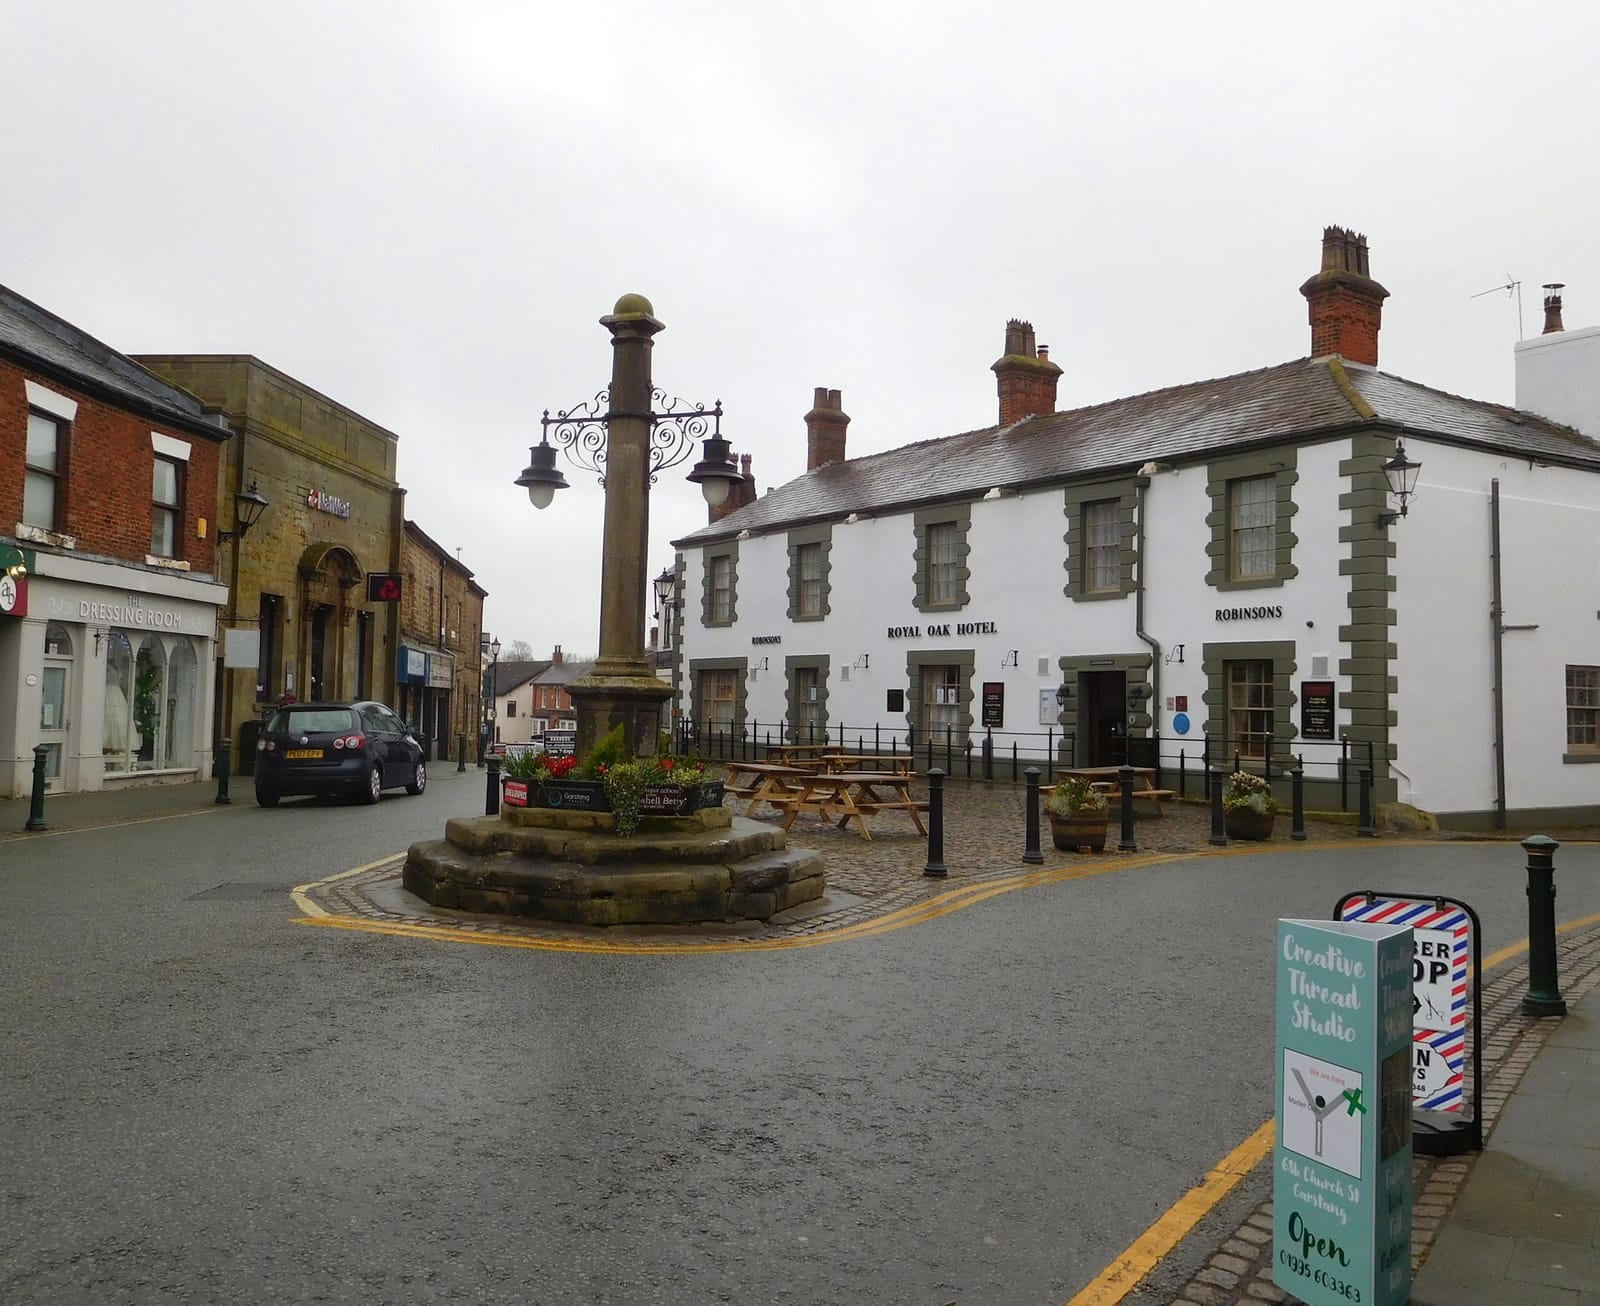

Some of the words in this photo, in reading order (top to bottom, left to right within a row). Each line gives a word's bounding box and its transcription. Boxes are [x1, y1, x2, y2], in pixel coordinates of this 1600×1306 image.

[79, 600, 143, 625] DRESSING
[147, 610, 182, 629] ROOM
[127, 595, 142, 607] THE
[1215, 605, 1283, 622] ROBINSONS
[752, 635, 782, 645] ROBINSONS
[887, 626, 922, 639] ROYAL
[927, 624, 951, 637] OAK
[956, 621, 998, 635] HOTEL
[564, 792, 590, 802] Garstang
[1283, 934, 1367, 979] Creative
[1287, 966, 1361, 1010] Thread
[1291, 999, 1356, 1042] Studio
[1310, 1068, 1320, 1076] We
[1288, 1096, 1307, 1110] Market
[1303, 1166, 1344, 1198] Church
[1347, 1184, 1361, 1205] St
[1293, 1182, 1347, 1227] Garstang
[1288, 1211, 1351, 1268] Open
[1279, 1249, 1312, 1279] 01995
[1314, 1269, 1361, 1304] 603363
